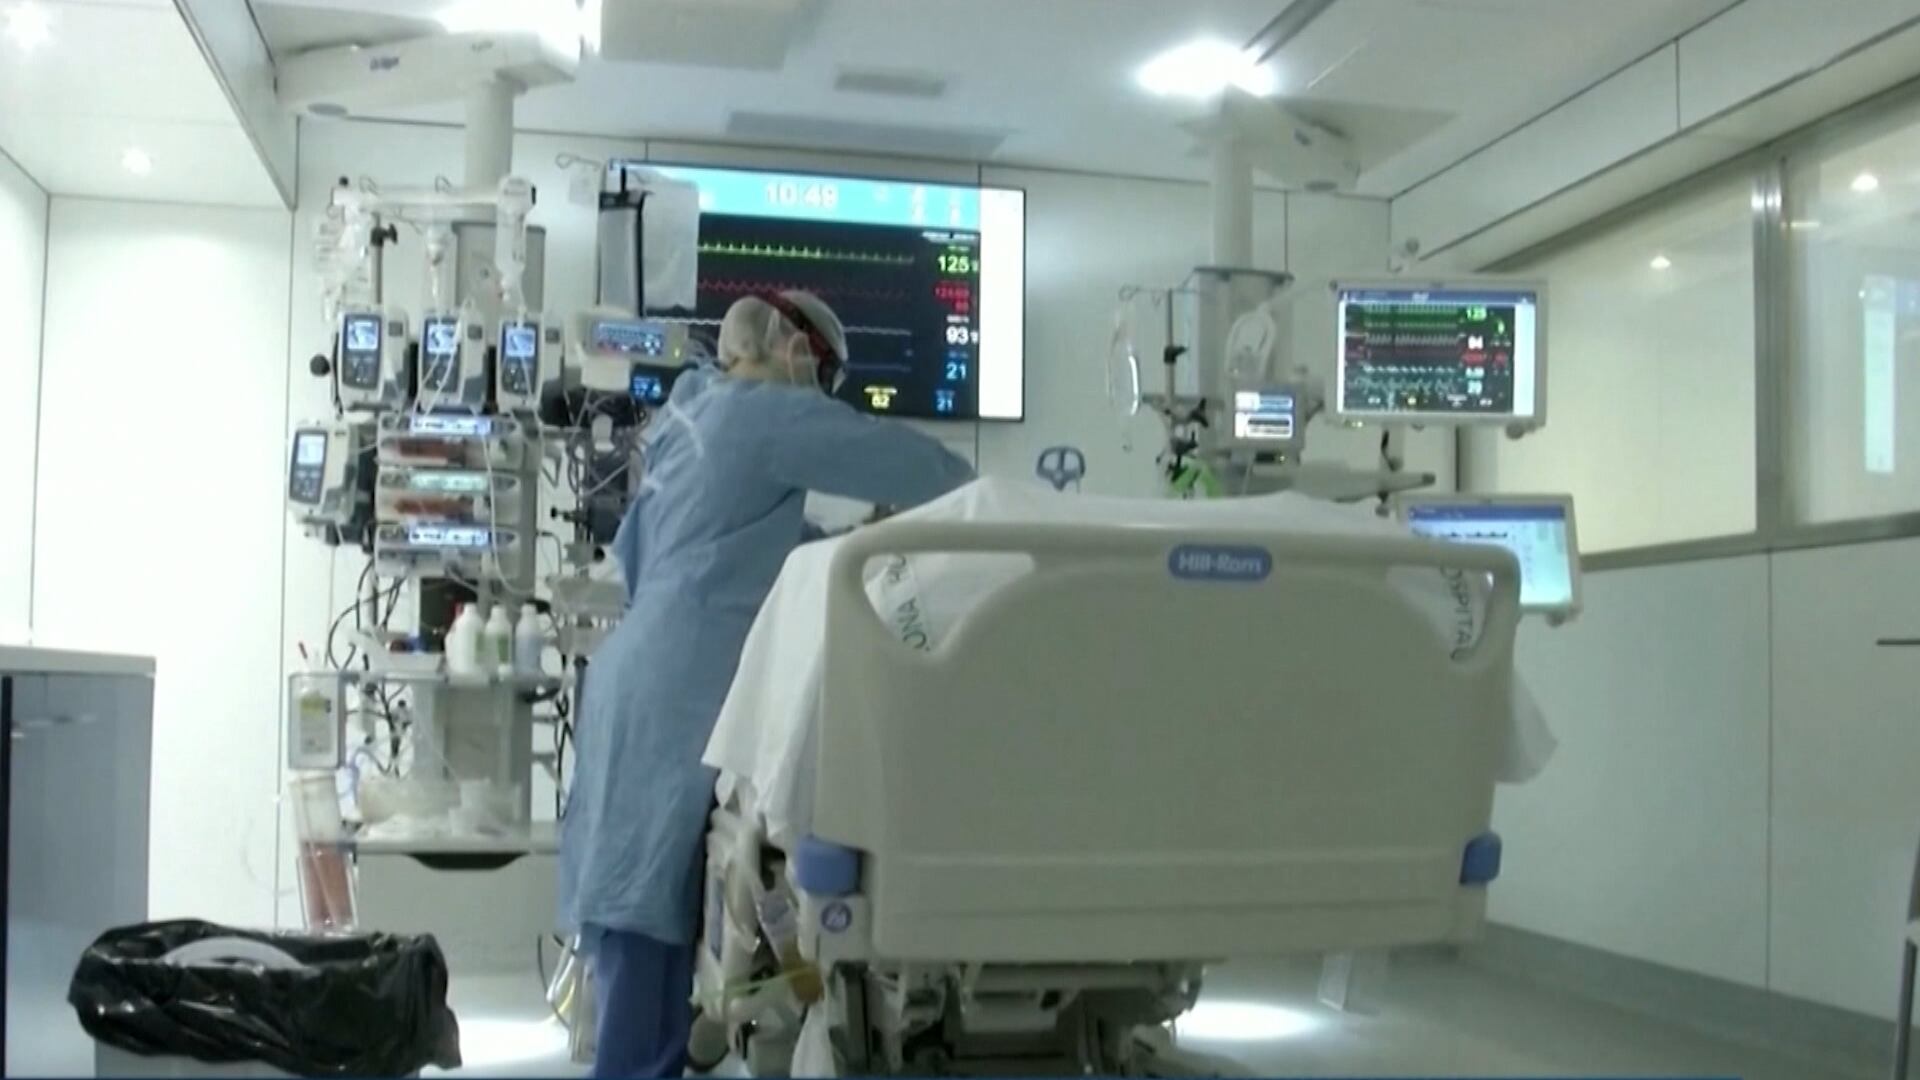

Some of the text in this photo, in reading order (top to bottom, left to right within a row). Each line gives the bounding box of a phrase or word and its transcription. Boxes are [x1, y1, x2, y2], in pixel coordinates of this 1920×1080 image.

[937, 254, 970, 274] 125
[946, 325, 970, 345] 93
[946, 361, 967, 380] 21
[1177, 549, 1262, 575] Hill-Rom
